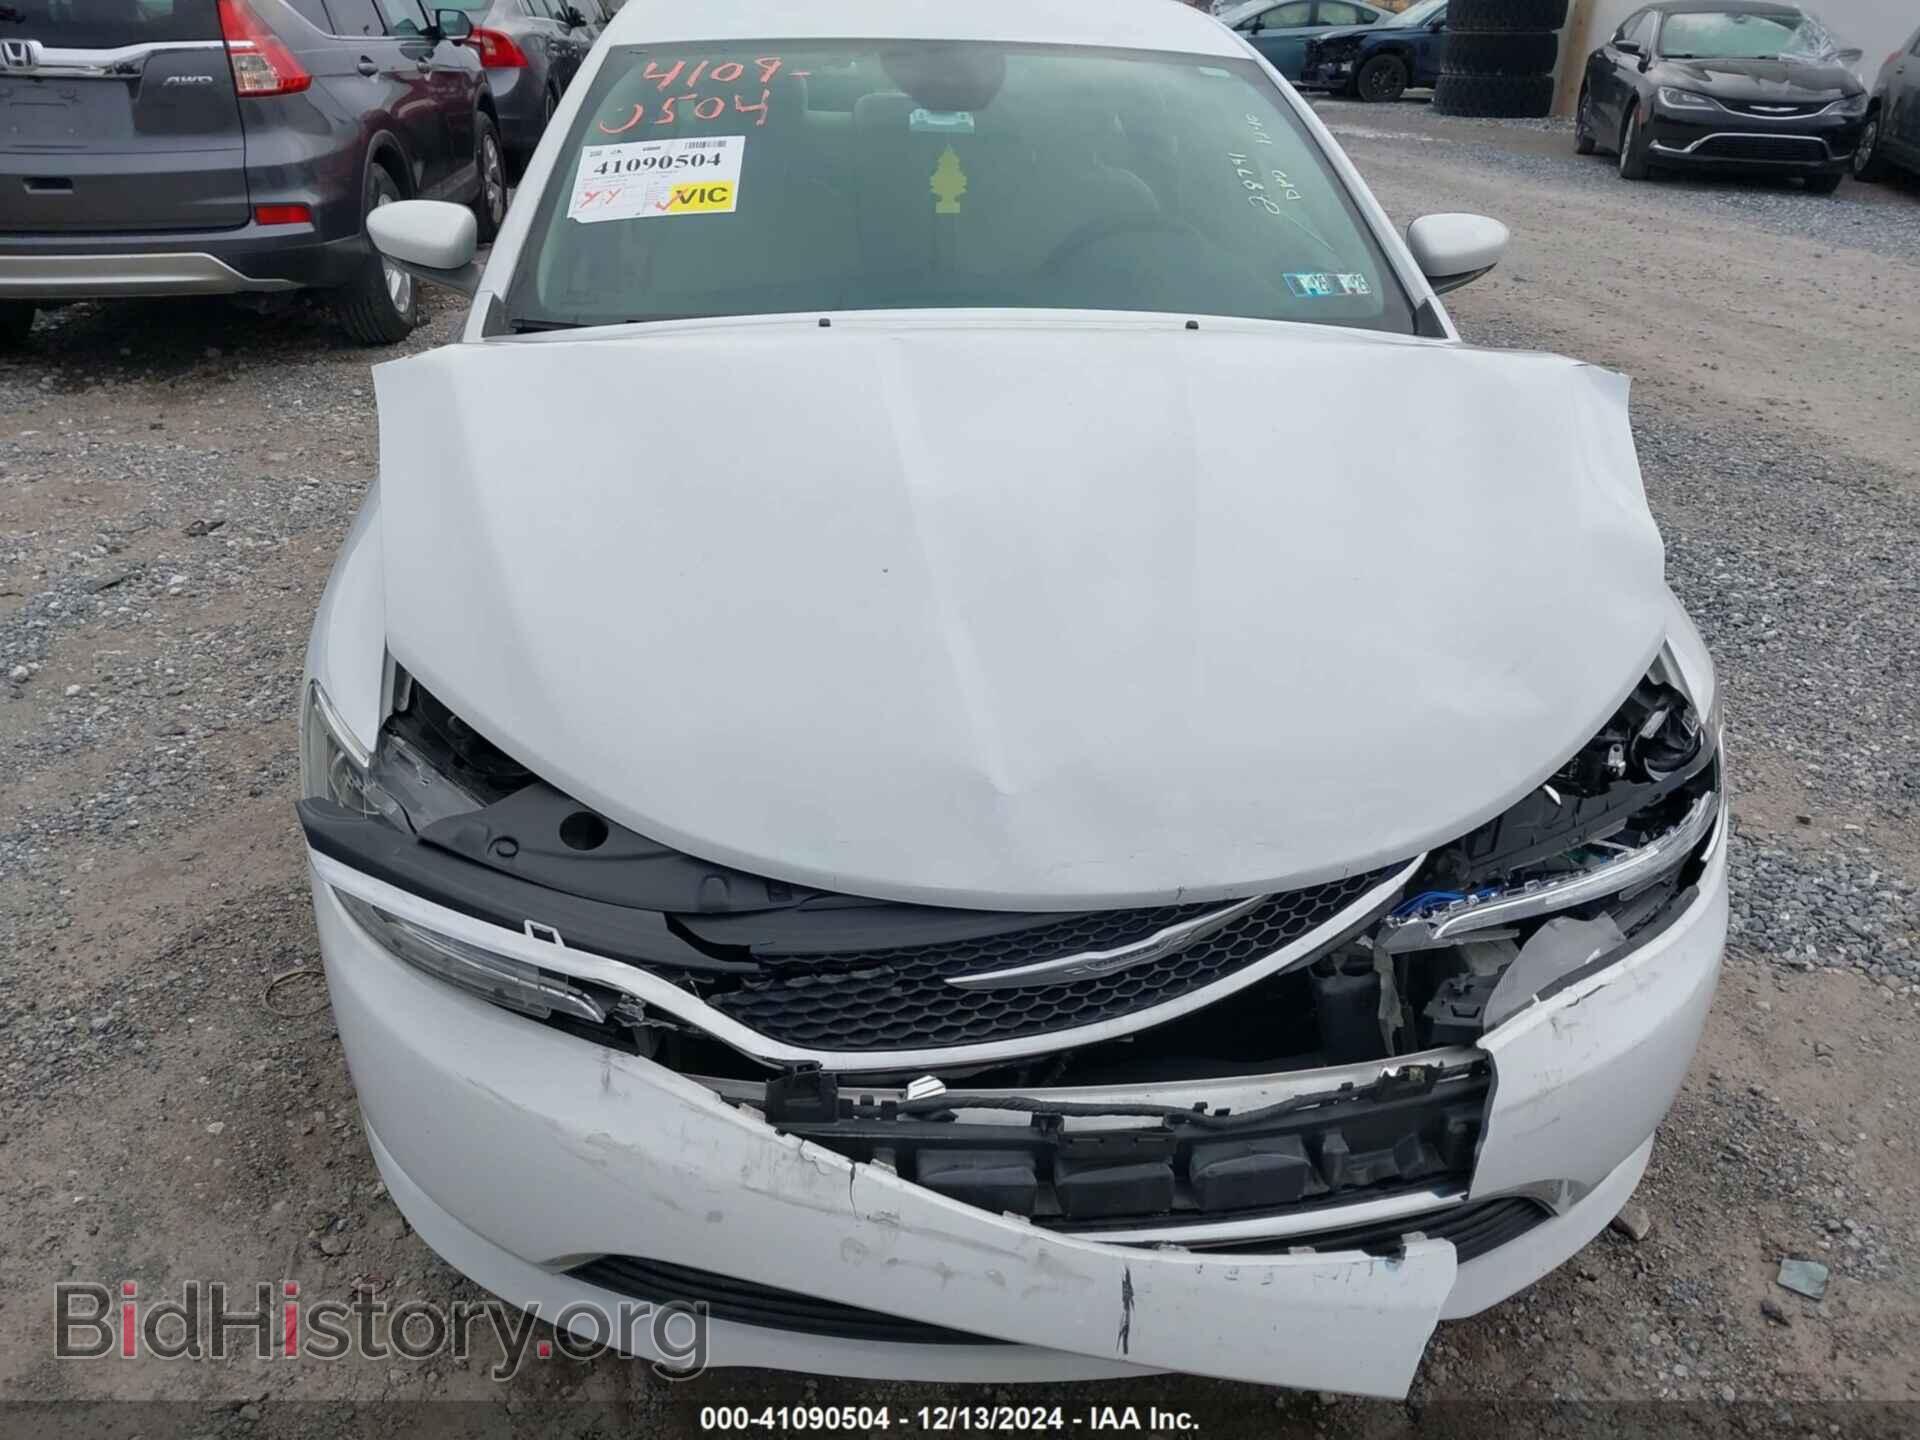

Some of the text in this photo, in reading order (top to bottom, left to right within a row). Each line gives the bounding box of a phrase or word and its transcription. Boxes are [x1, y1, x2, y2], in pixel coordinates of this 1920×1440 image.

[163, 75, 213, 86] AWD
[593, 151, 722, 176] 41090504
[675, 186, 729, 205] VIC
